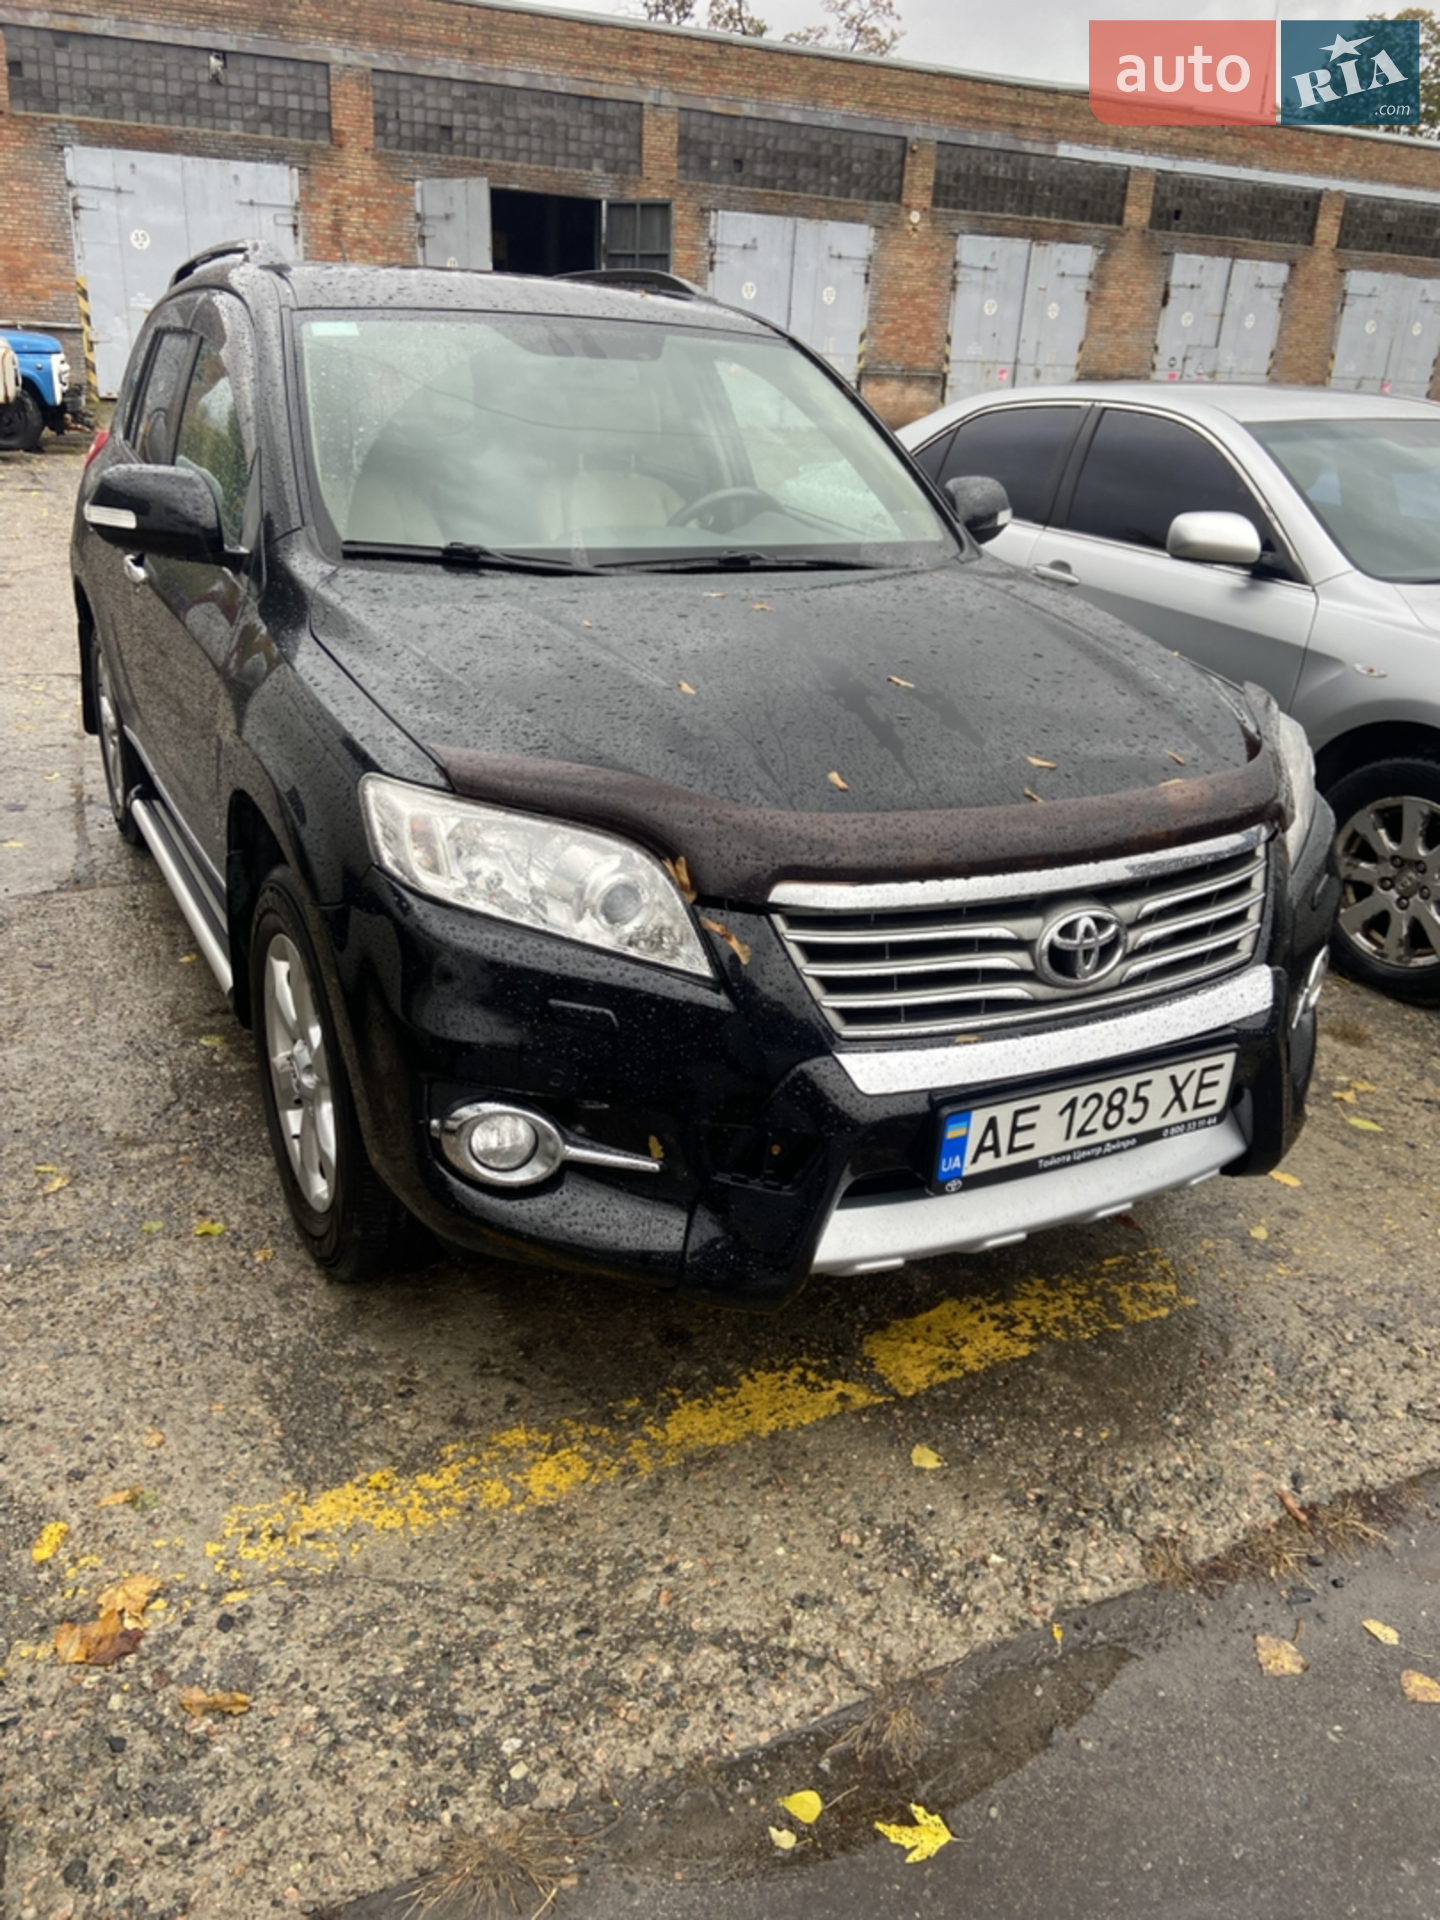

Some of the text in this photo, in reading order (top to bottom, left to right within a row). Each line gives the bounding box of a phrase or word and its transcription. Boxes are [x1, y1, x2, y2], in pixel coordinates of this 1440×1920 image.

[970, 1063, 1225, 1165] AE 1285 XE
[941, 1154, 961, 1172] UA
